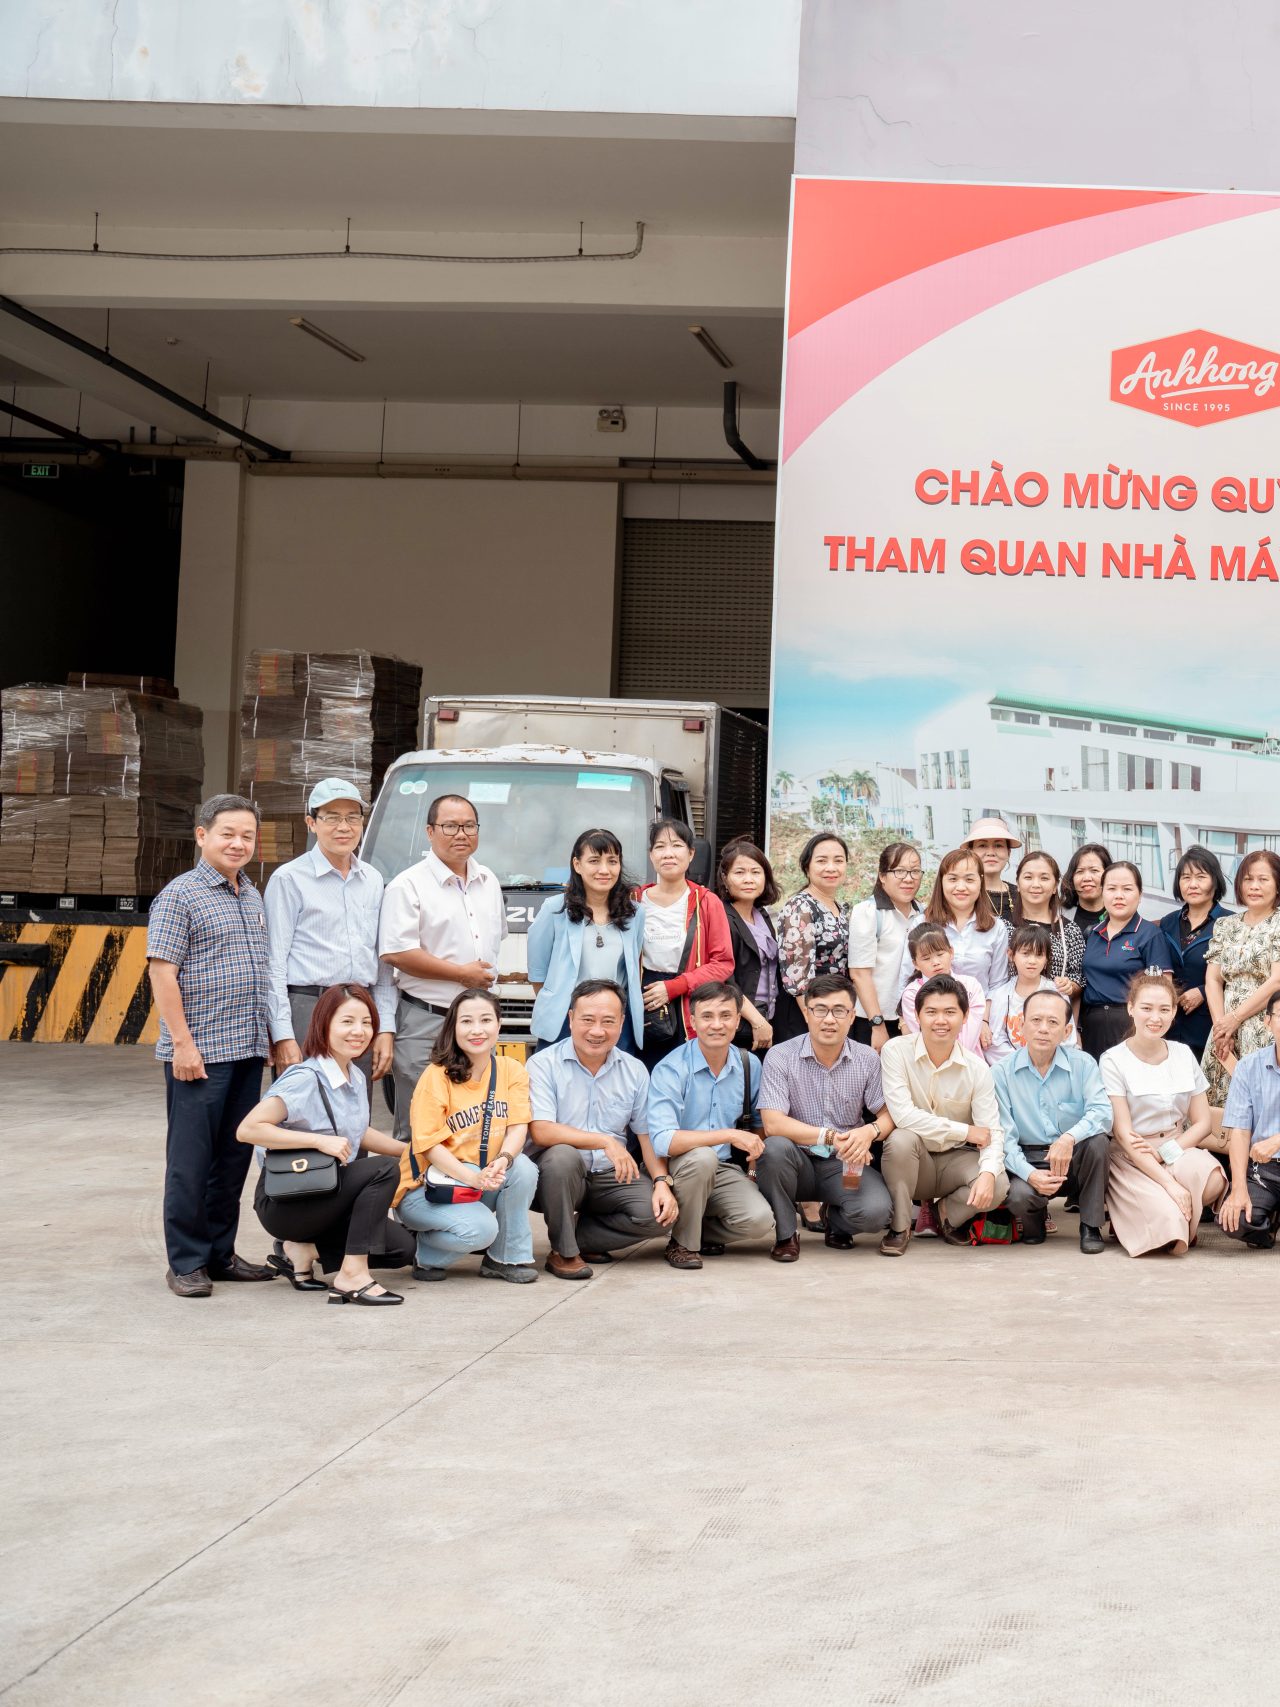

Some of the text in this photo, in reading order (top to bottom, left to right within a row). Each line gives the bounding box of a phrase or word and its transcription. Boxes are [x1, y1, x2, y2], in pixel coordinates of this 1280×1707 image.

[1119, 345, 1279, 400] Anhhong
[1163, 402, 1231, 412] SINCE 1995
[31, 465, 50, 476] EXIT
[915, 460, 1049, 507] CHÀO
[1064, 464, 1198, 511] MỪNG
[824, 535, 946, 573] THAM
[960, 539, 1086, 577] QUAN
[1102, 534, 1197, 580] NHÀ
[482, 1090, 496, 1140] TOMMY JEANS
